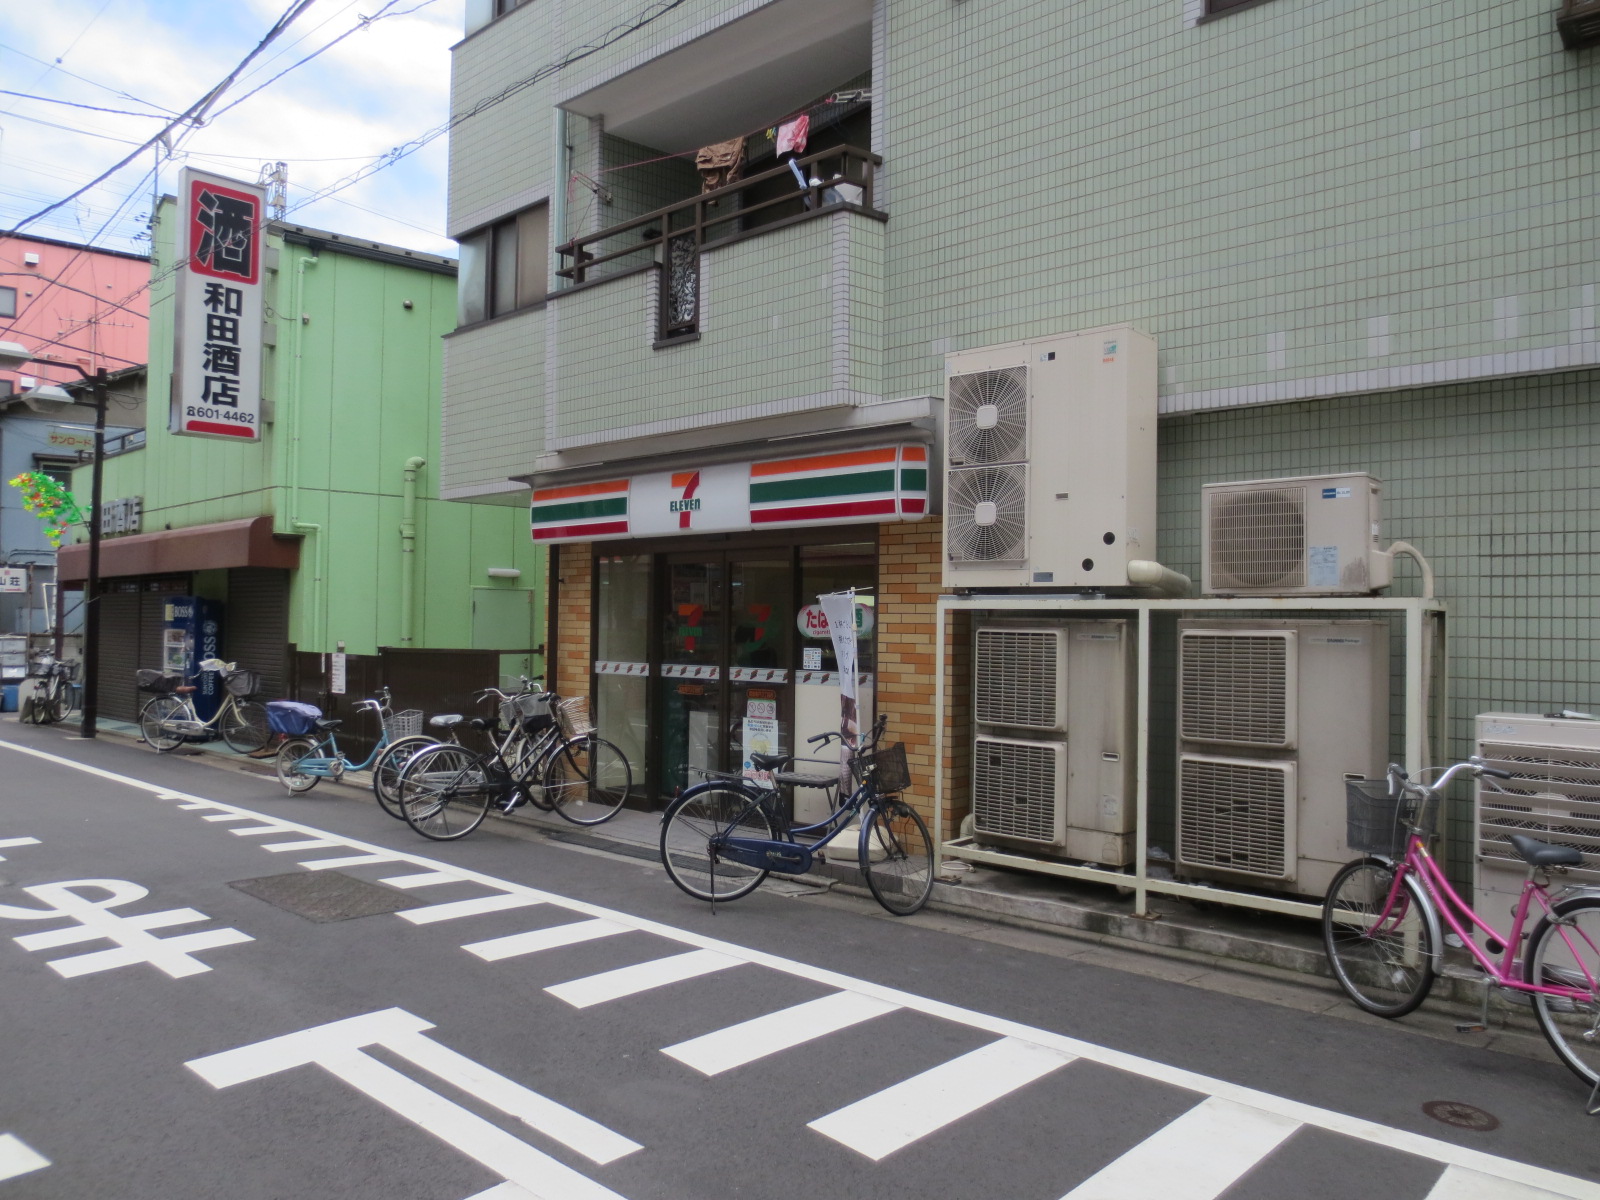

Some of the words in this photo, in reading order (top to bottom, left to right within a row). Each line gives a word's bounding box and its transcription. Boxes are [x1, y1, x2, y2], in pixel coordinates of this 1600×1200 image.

[201, 282, 243, 408] 和田酒店
[671, 470, 700, 529] 7
[174, 606, 188, 618] BOSS
